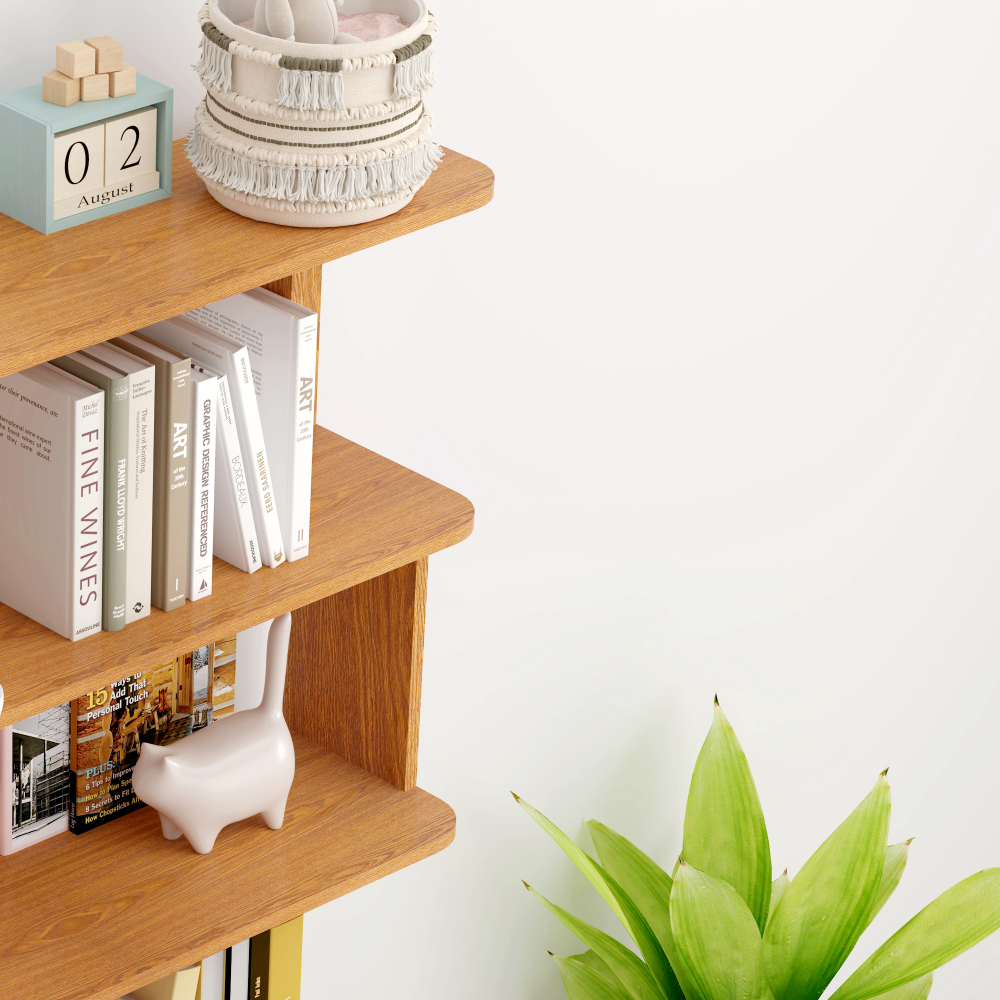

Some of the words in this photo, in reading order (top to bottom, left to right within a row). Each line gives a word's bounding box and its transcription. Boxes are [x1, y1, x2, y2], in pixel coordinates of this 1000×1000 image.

[77, 182, 134, 209] August
[299, 377, 313, 412] ART
[202, 399, 211, 447] GRAPHIC
[6, 434, 18, 446] they
[37, 433, 52, 446] expert
[142, 436, 147, 444] of
[173, 423, 188, 458] ART
[297, 433, 312, 443] Century
[81, 429, 99, 497] FINE
[140, 444, 148, 474] Knitting
[201, 448, 210, 488] DESIGN
[256, 450, 270, 492] SAARINEN
[117, 459, 126, 487] FRANK
[171, 481, 187, 490] Century
[232, 455, 248, 508] BORDEAUX
[117, 488, 125, 516] LLOYD
[264, 492, 274, 513] EERO
[117, 517, 125, 551] WRIGHT
[200, 489, 209, 557] REFERENCED
[79, 506, 98, 606] WINES
[76, 621, 101, 635] ASSOULINE
[87, 687, 108, 710] 15
[110, 686, 126, 700] Add
[129, 678, 147, 693] That
[87, 700, 122, 722] Personal
[125, 690, 149, 706] Touch
[85, 760, 115, 779] PLUS:
[85, 792, 98, 802] How
[107, 783, 119, 793] Plan
[92, 779, 104, 788] Tips
[85, 805, 90, 813] 8
[91, 797, 113, 811] Secrets
[85, 815, 98, 824] How
[99, 800, 130, 818] Chopsticks
